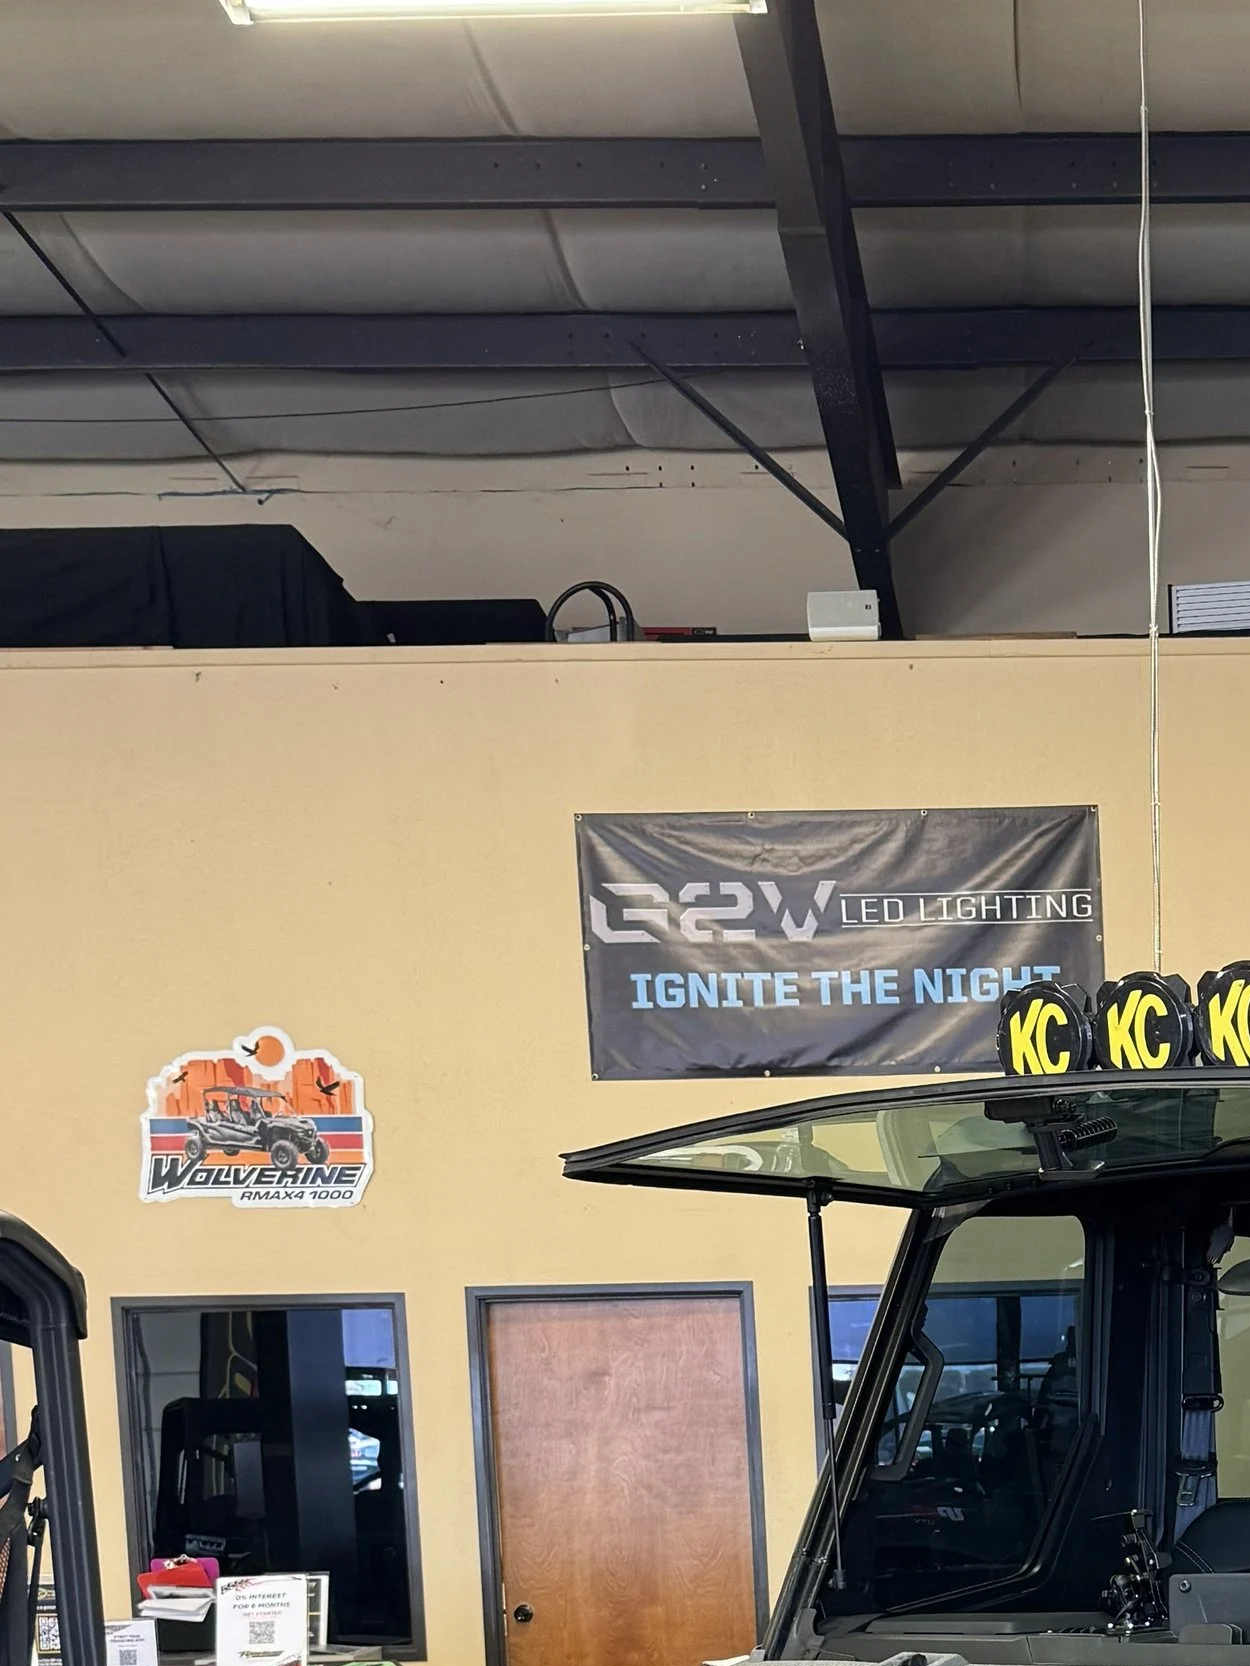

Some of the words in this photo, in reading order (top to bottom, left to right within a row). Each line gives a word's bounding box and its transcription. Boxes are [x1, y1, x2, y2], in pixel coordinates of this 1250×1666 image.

[839, 895, 905, 924] LED
[919, 891, 1093, 922] LIGHTING
[631, 969, 800, 1010] IGNITE
[812, 967, 899, 1006] THE
[1009, 998, 1071, 1076] KC
[1107, 989, 1171, 1070] KC
[240, 1190, 304, 1200] RMAX4
[309, 1190, 354, 1200] 1000
